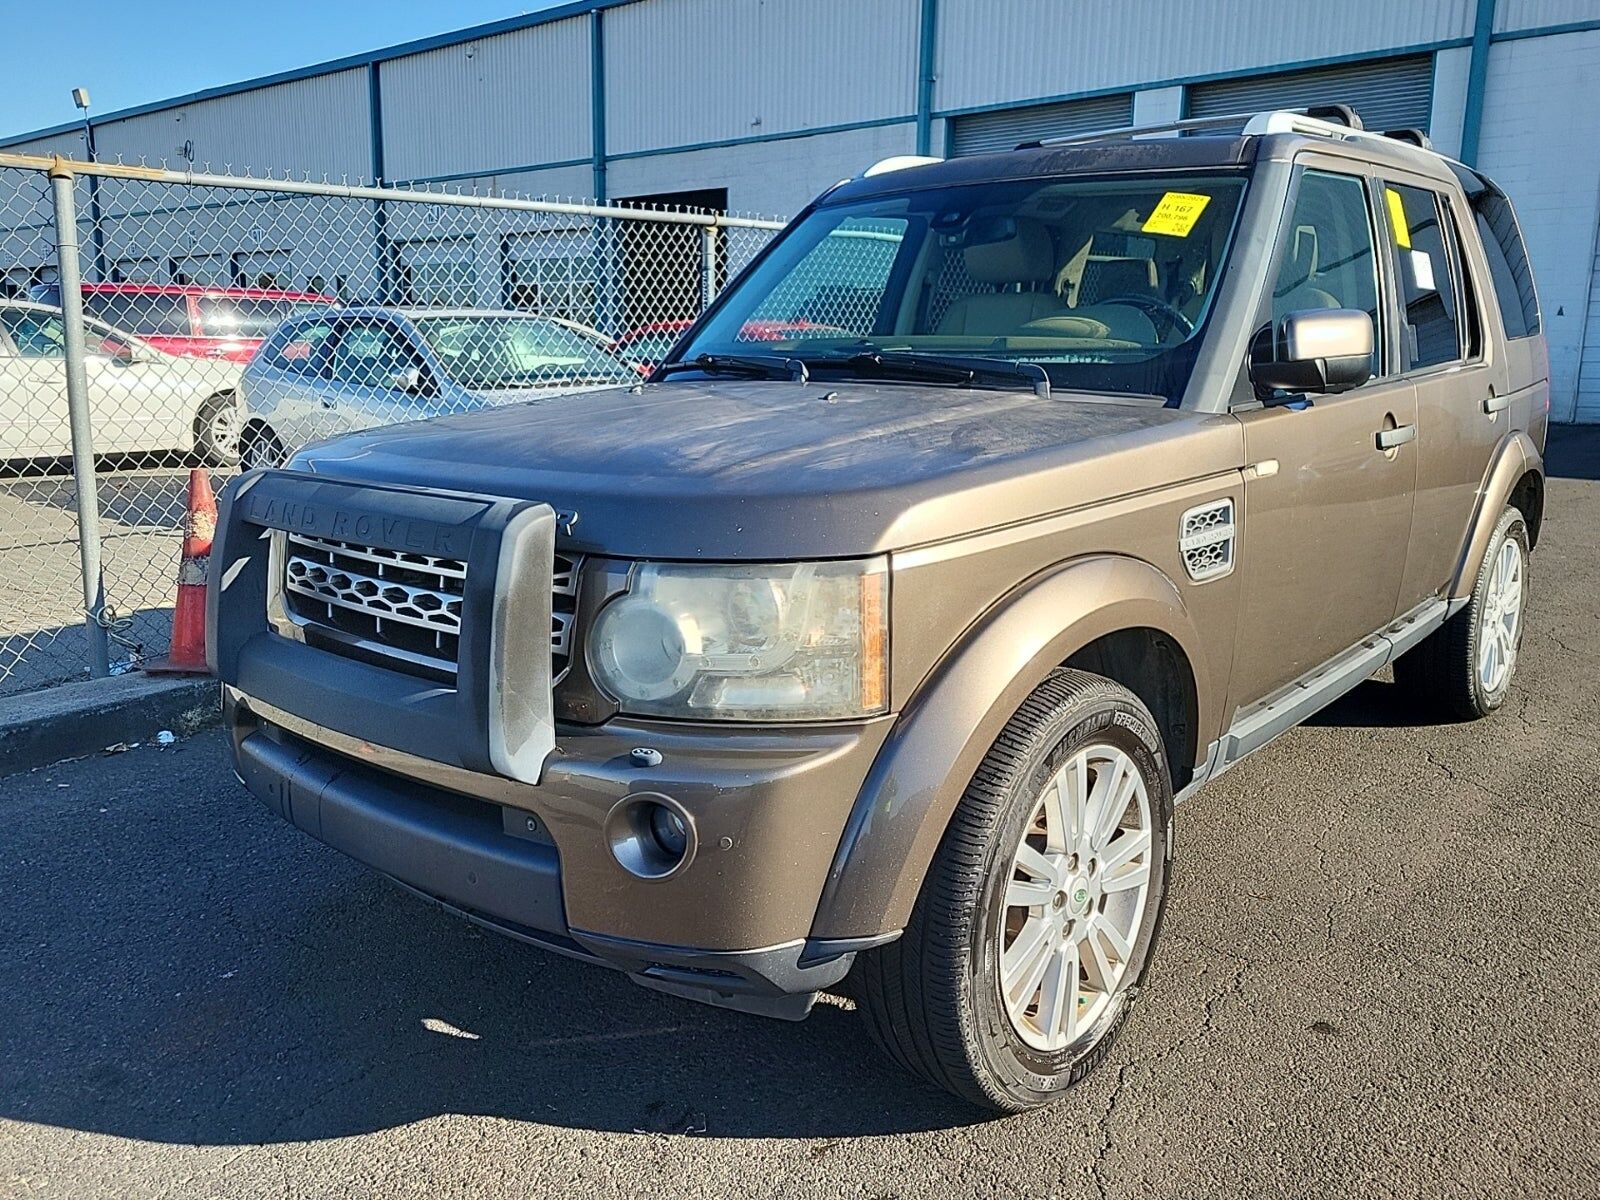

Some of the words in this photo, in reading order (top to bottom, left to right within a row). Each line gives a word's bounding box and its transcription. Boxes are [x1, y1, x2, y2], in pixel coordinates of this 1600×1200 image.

[1174, 205, 1194, 213] 167
[249, 495, 318, 530] LAND
[330, 511, 454, 553] ROVER
[1115, 713, 1146, 738] PREMIER
